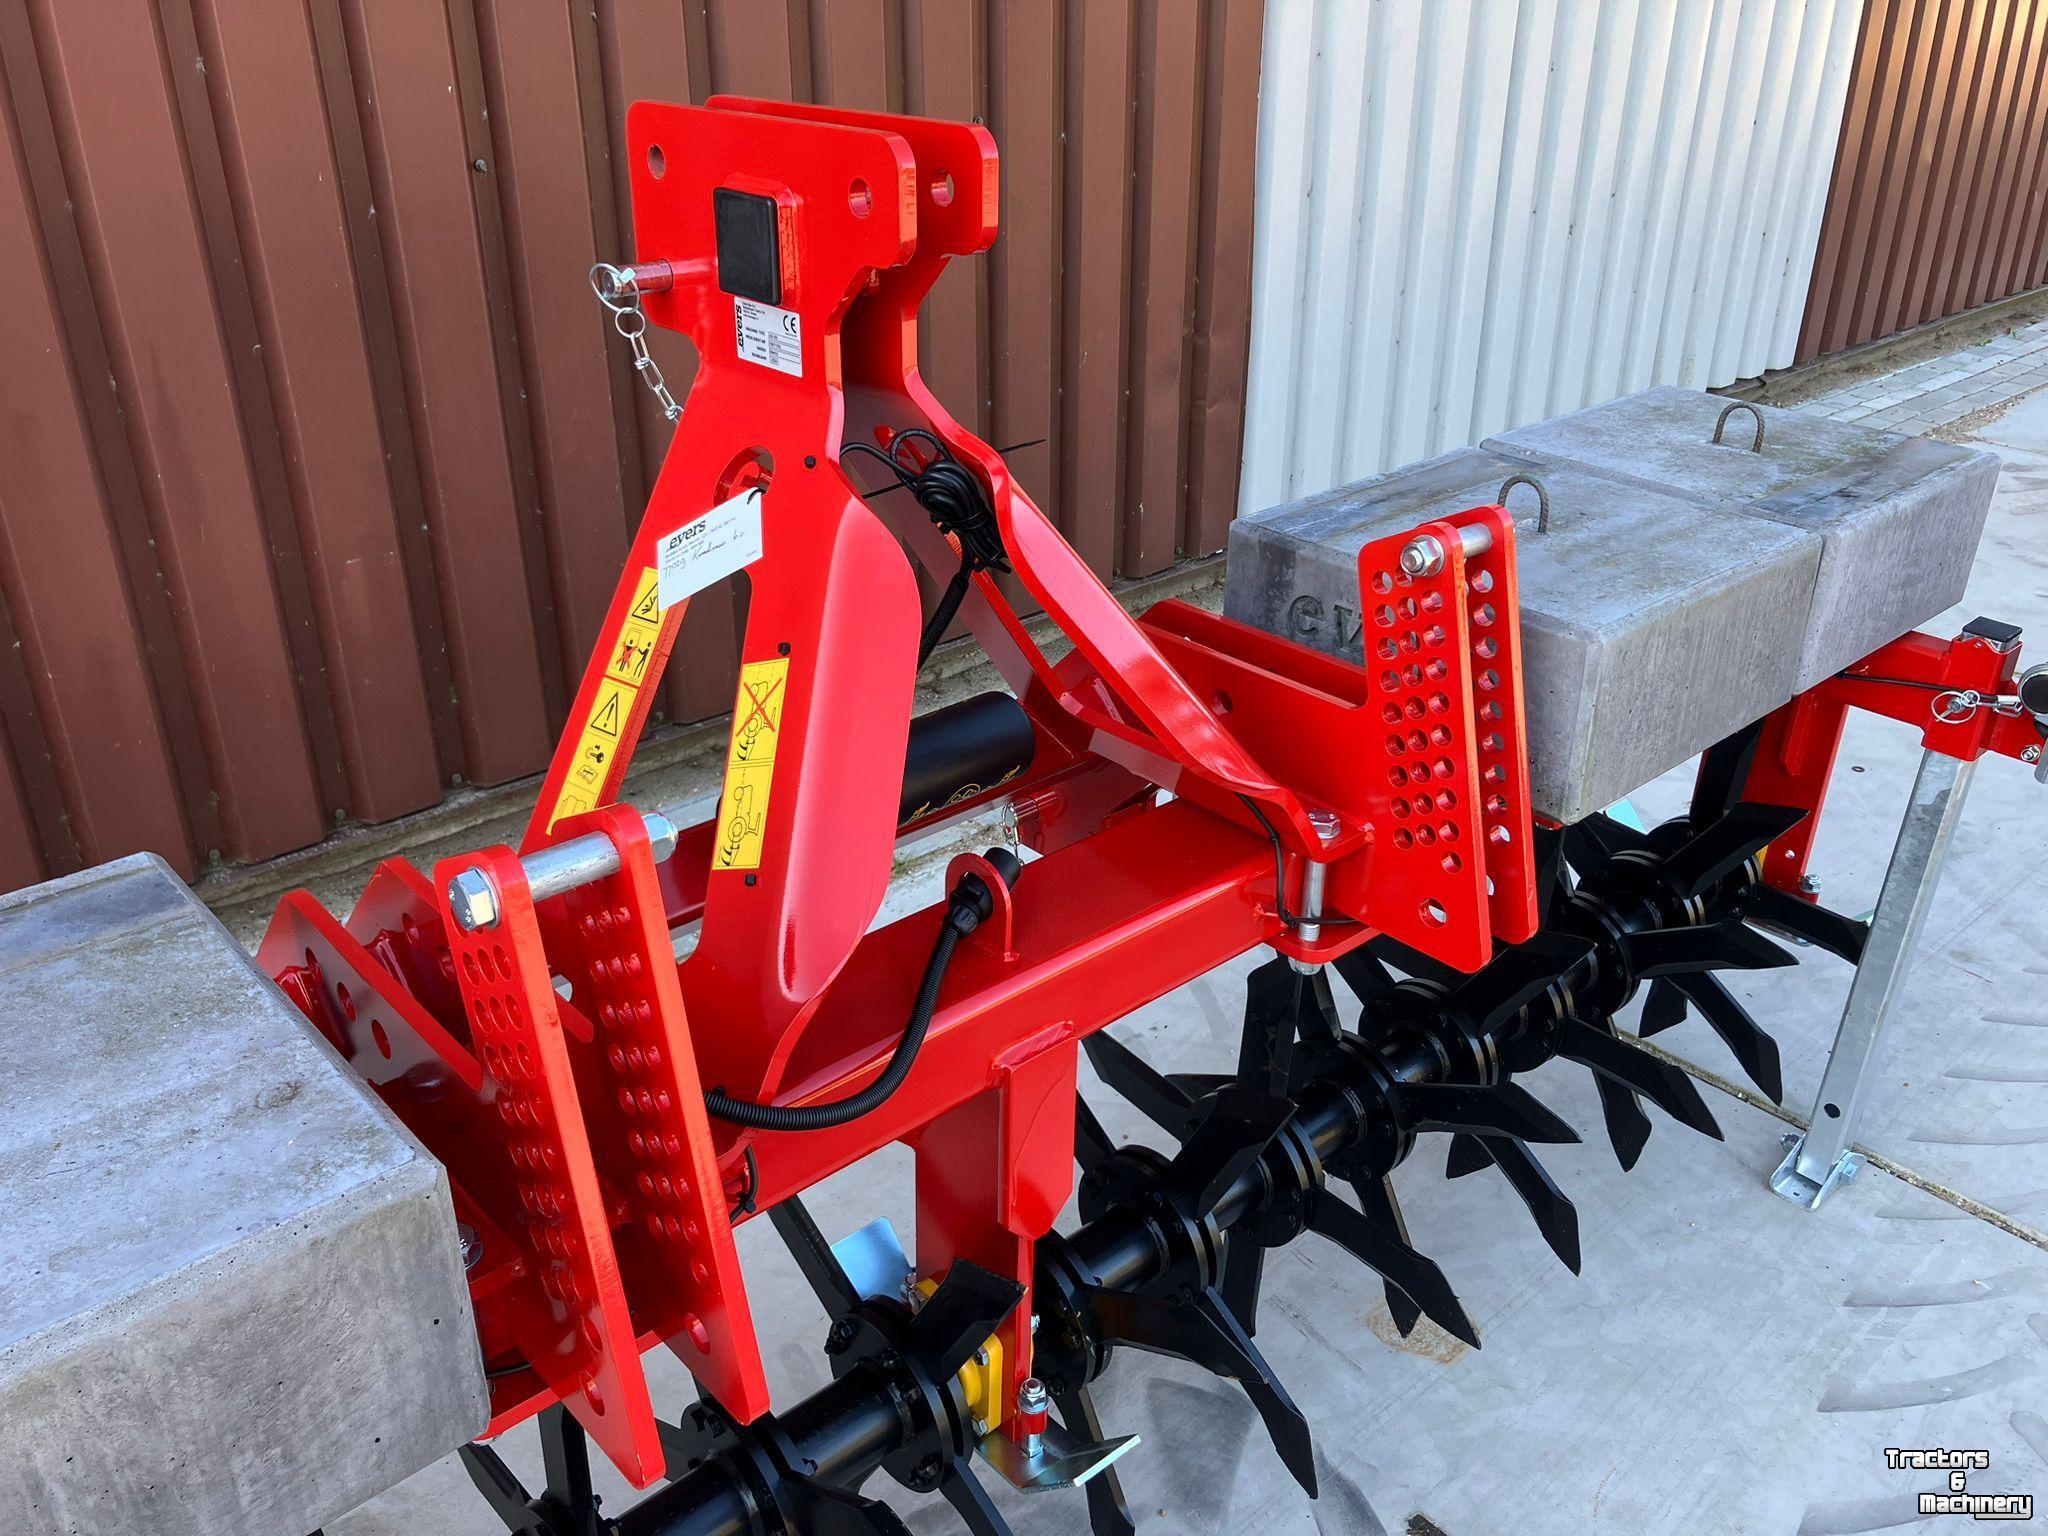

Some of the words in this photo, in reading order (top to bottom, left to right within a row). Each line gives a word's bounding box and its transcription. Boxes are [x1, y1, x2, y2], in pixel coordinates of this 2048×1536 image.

[736, 304, 744, 352] evers
[783, 315, 797, 334] CE
[668, 520, 706, 550] evers
